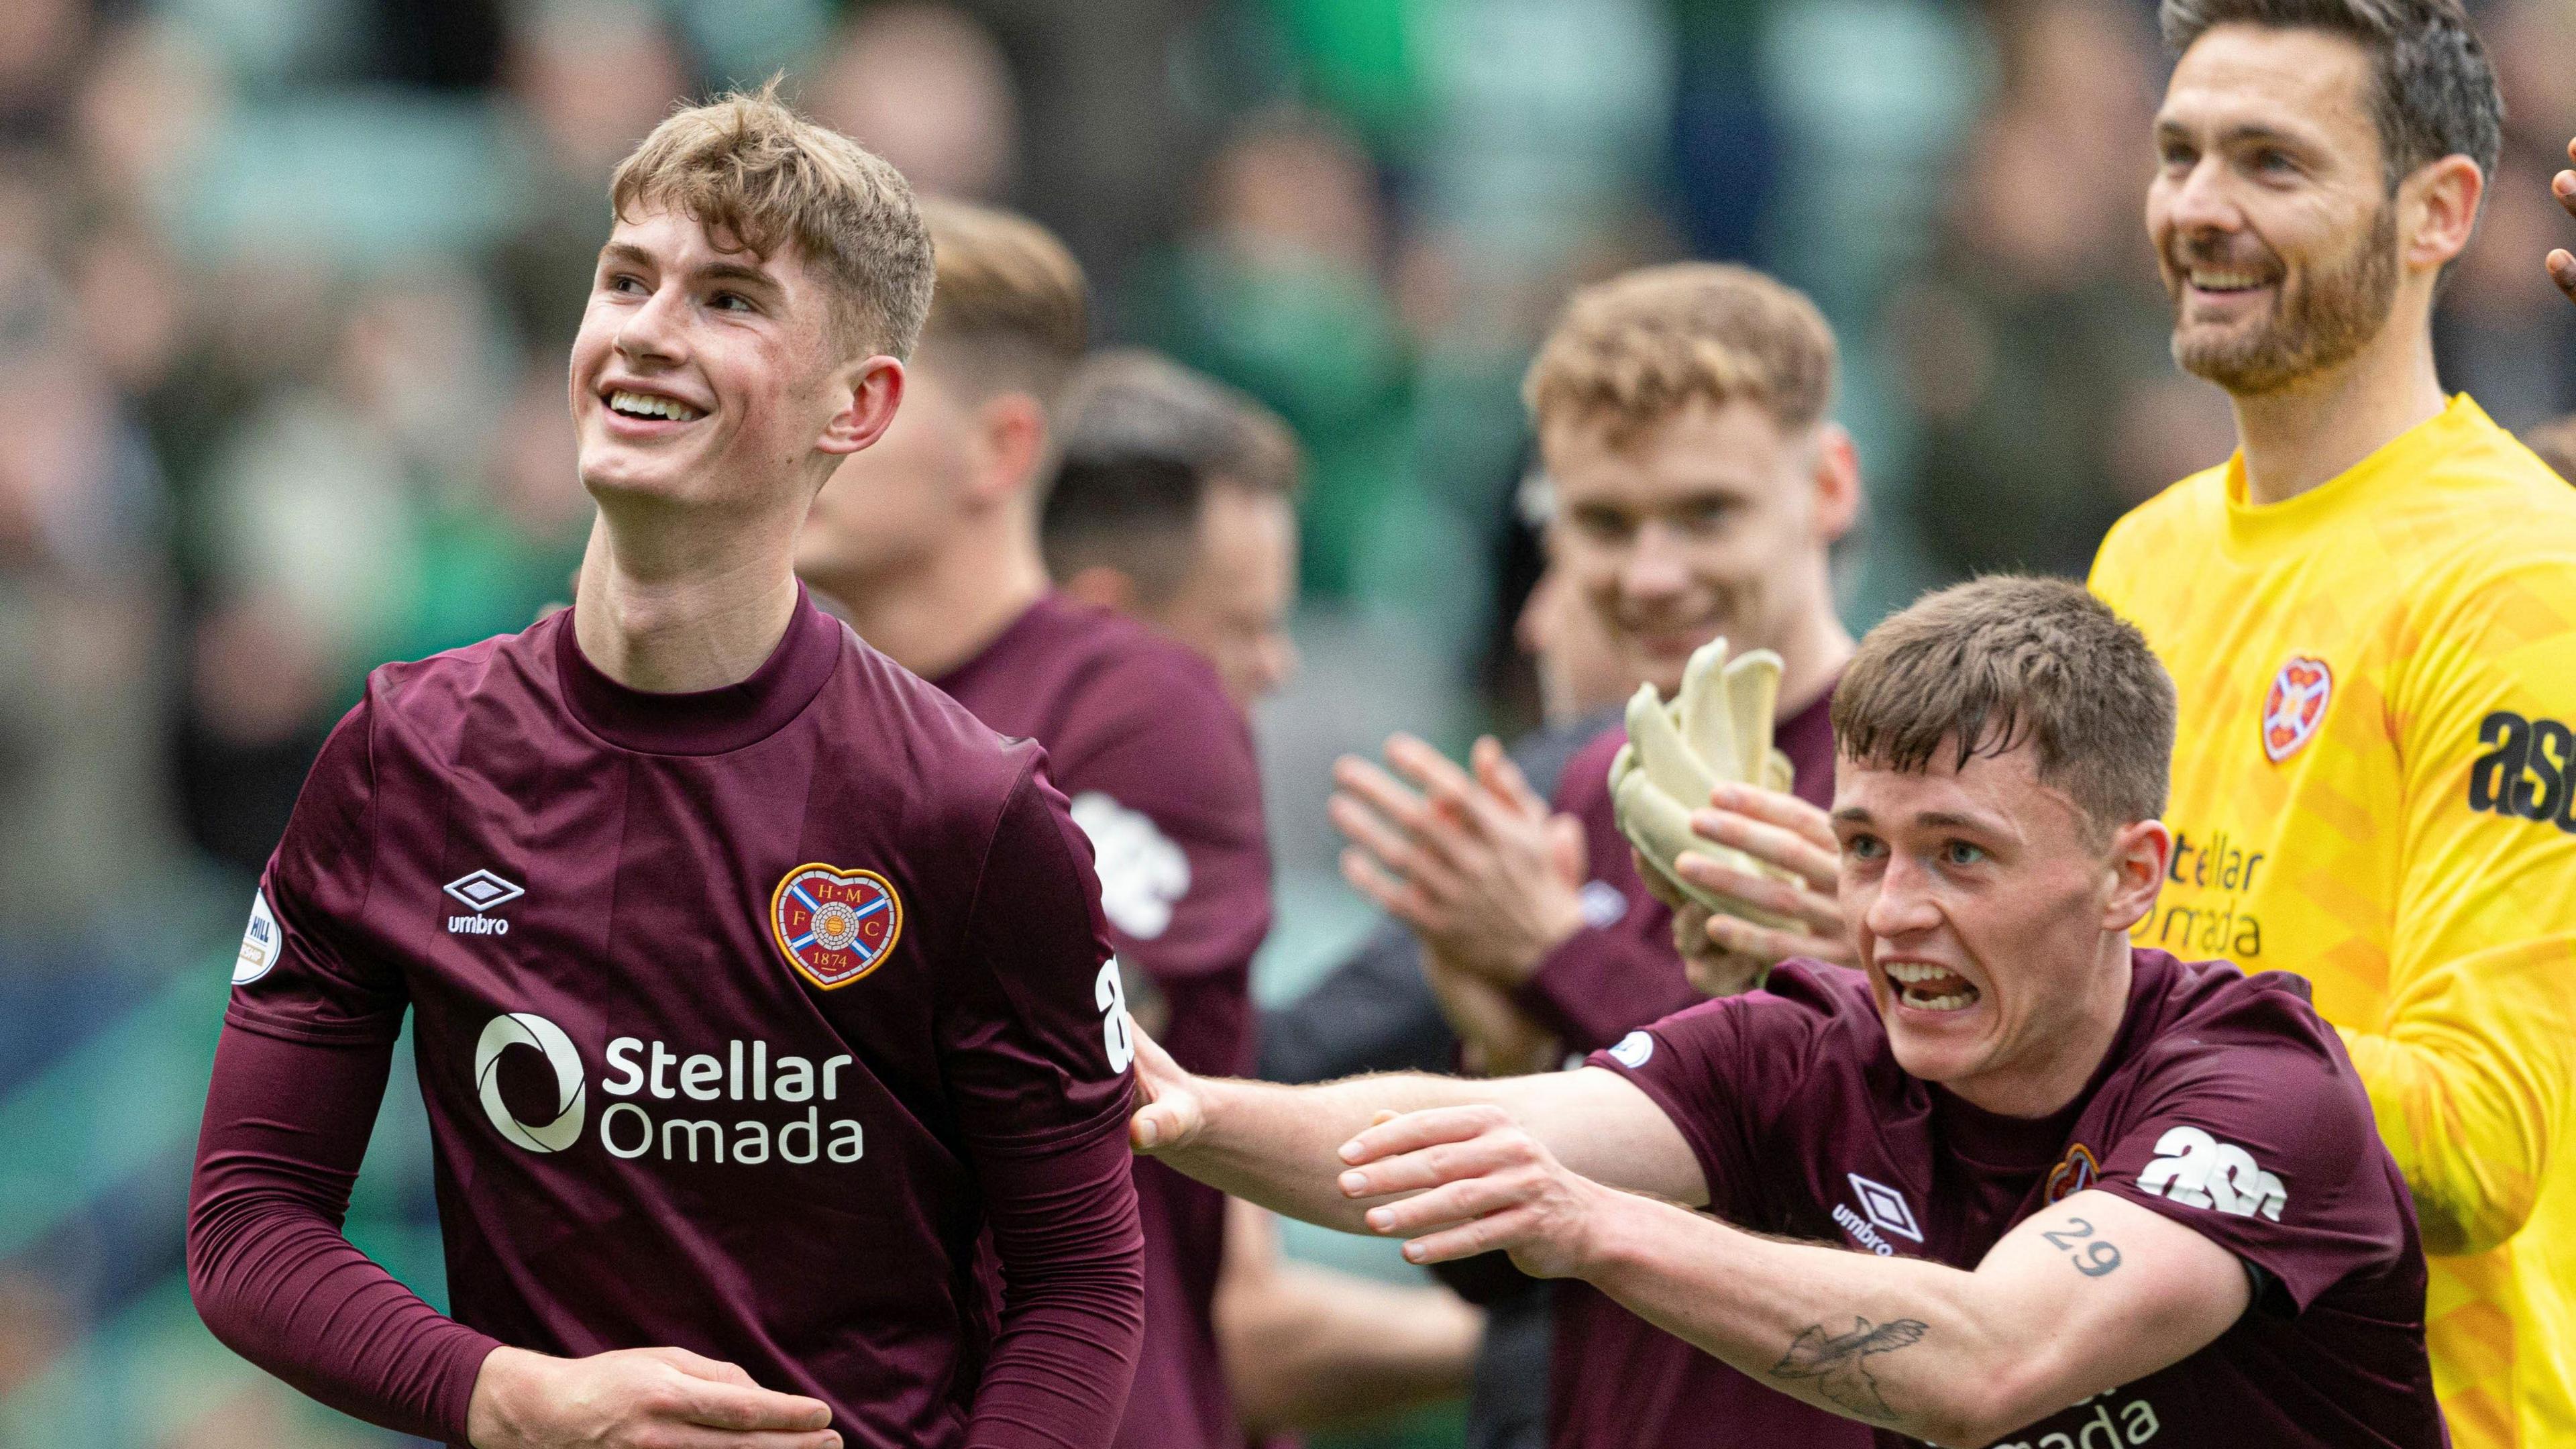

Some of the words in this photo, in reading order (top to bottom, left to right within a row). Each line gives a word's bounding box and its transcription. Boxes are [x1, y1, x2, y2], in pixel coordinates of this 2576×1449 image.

[2167, 832, 2264, 890] tellar
[250, 916, 270, 943] HILL
[447, 913, 509, 935] umbro
[813, 952, 847, 968] 1874
[602, 1036, 853, 1102] Stellar
[600, 1102, 863, 1165] Omada
[1831, 1203, 1894, 1257] umbro
[2041, 1218, 2122, 1277] 29
